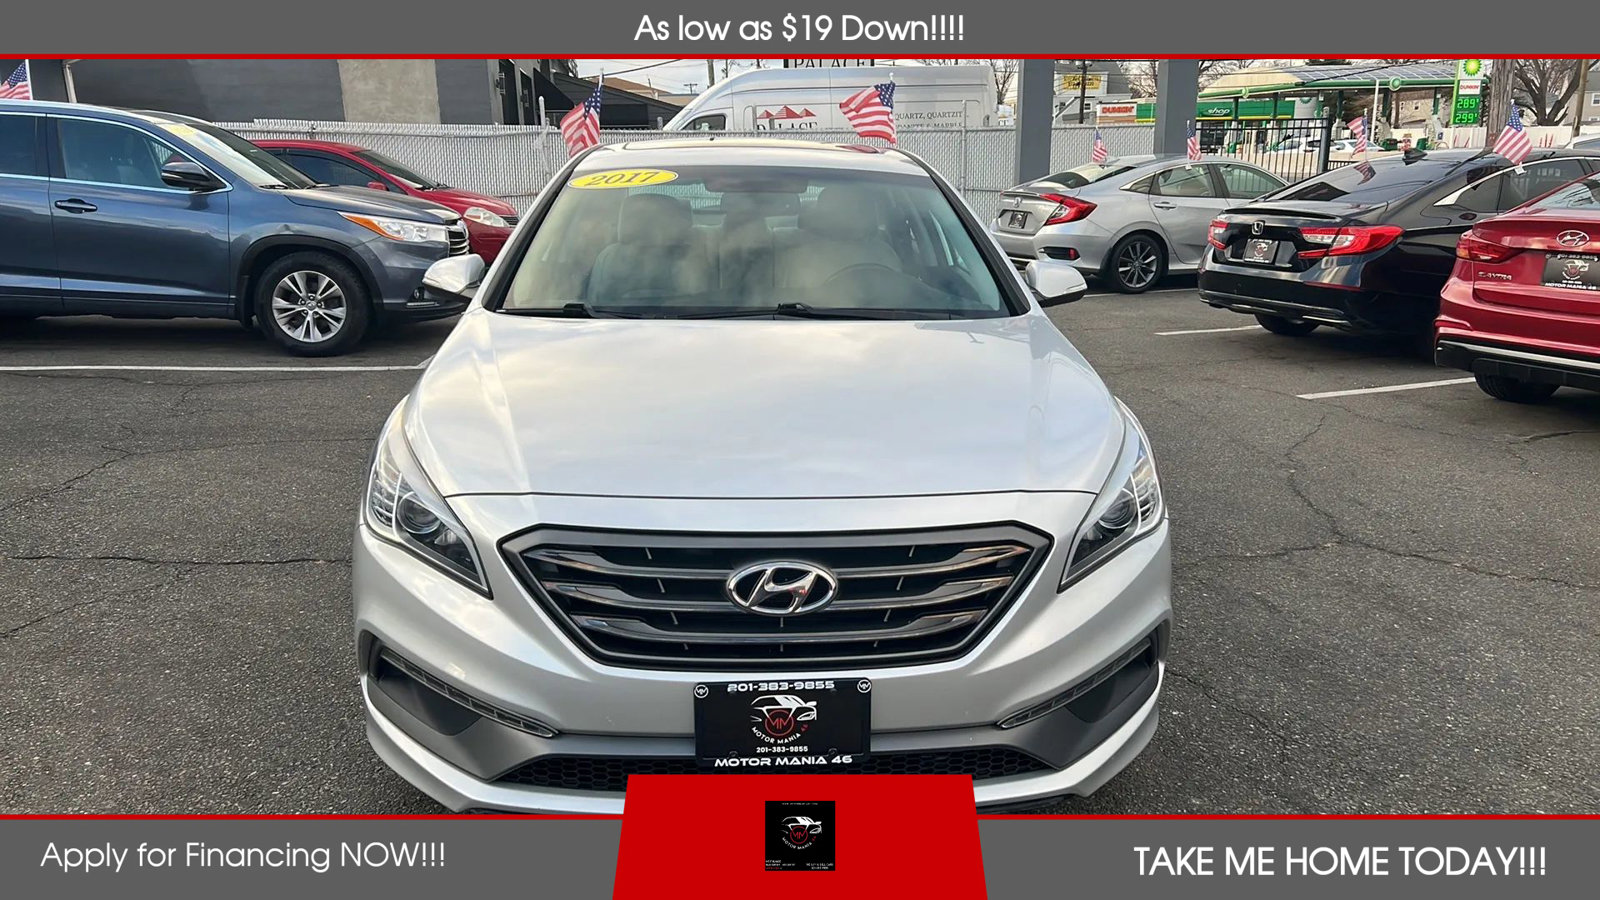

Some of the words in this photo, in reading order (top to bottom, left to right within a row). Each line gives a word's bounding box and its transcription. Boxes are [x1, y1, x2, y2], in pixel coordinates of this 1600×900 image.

[1208, 107, 1231, 115] shop
[584, 171, 660, 187] 2017
[727, 680, 835, 693] 201-383-9855
[752, 726, 775, 743] MOTOR
[777, 732, 801, 744] MANIA
[756, 745, 809, 753] 201-383-9855
[714, 757, 771, 767] MOTOR
[775, 755, 828, 766] MANIA
[831, 754, 853, 764] 46
